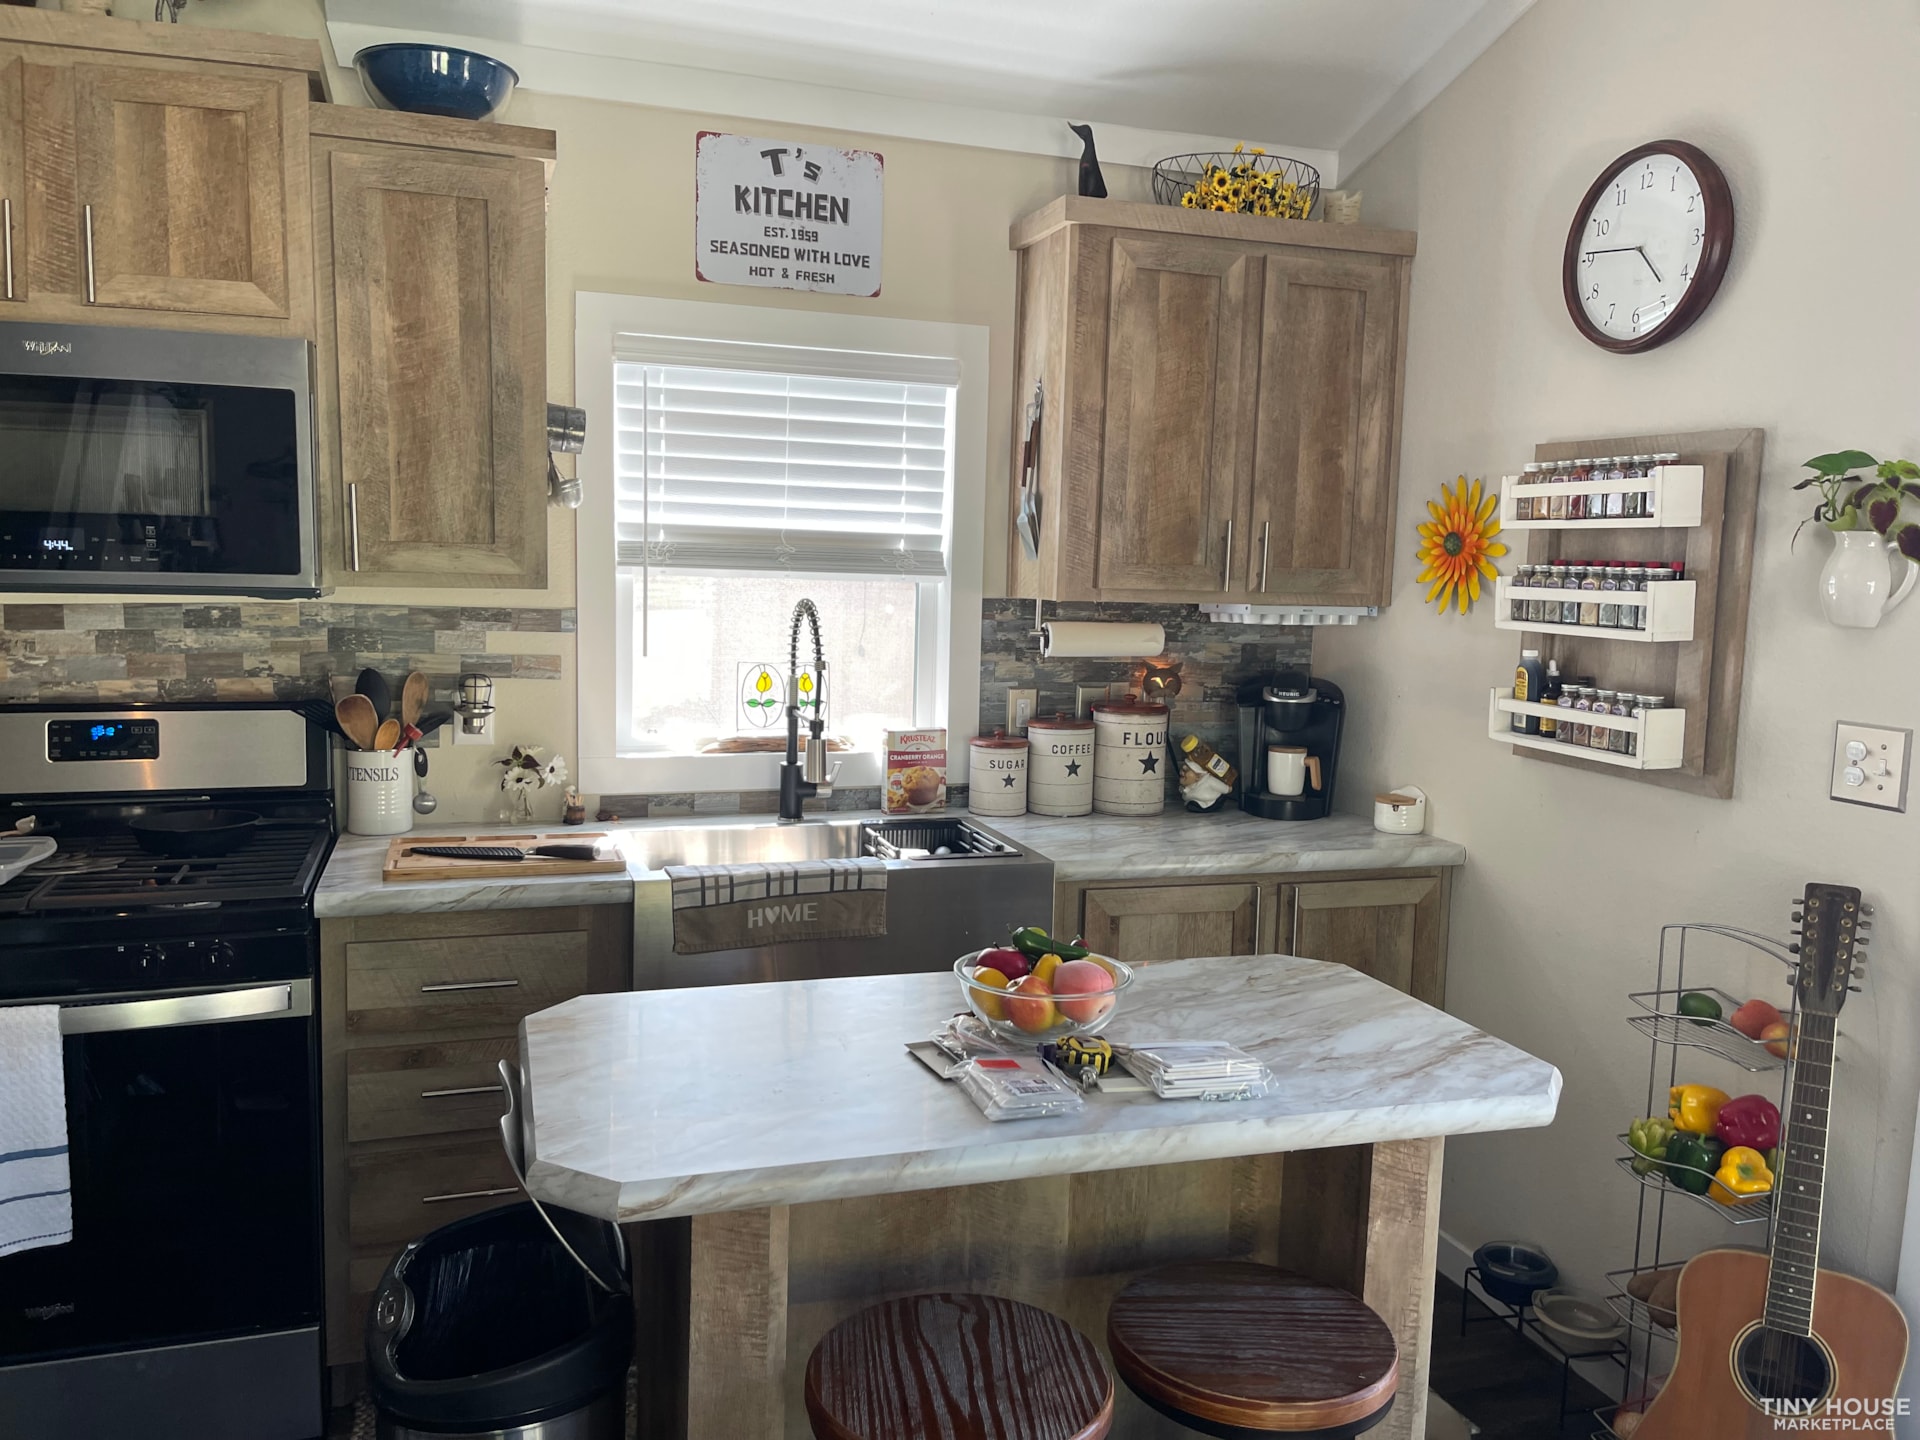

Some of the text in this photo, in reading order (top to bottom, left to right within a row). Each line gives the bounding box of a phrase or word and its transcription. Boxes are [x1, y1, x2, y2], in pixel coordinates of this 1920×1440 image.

[760, 148, 823, 183] T's
[1640, 171, 1654, 190] 12
[1670, 175, 1676, 192] 1
[734, 184, 850, 225] KITCHEN
[1615, 189, 1627, 206] 11
[1687, 196, 1695, 213] 2
[1595, 219, 1610, 237] 10
[1691, 228, 1700, 246] 3
[710, 240, 870, 269] SEASONED WITH LOVE
[1587, 253, 1595, 268] 9
[749, 266, 835, 284] HOT & FRESH
[1680, 263, 1689, 282] 4
[1591, 283, 1599, 299] 8
[1608, 303, 1616, 320] 7
[1658, 295, 1667, 312] 5
[1631, 307, 1640, 324] 6
[1051, 743, 1091, 755] COFFEE
[989, 759, 1025, 770] SUGAR
